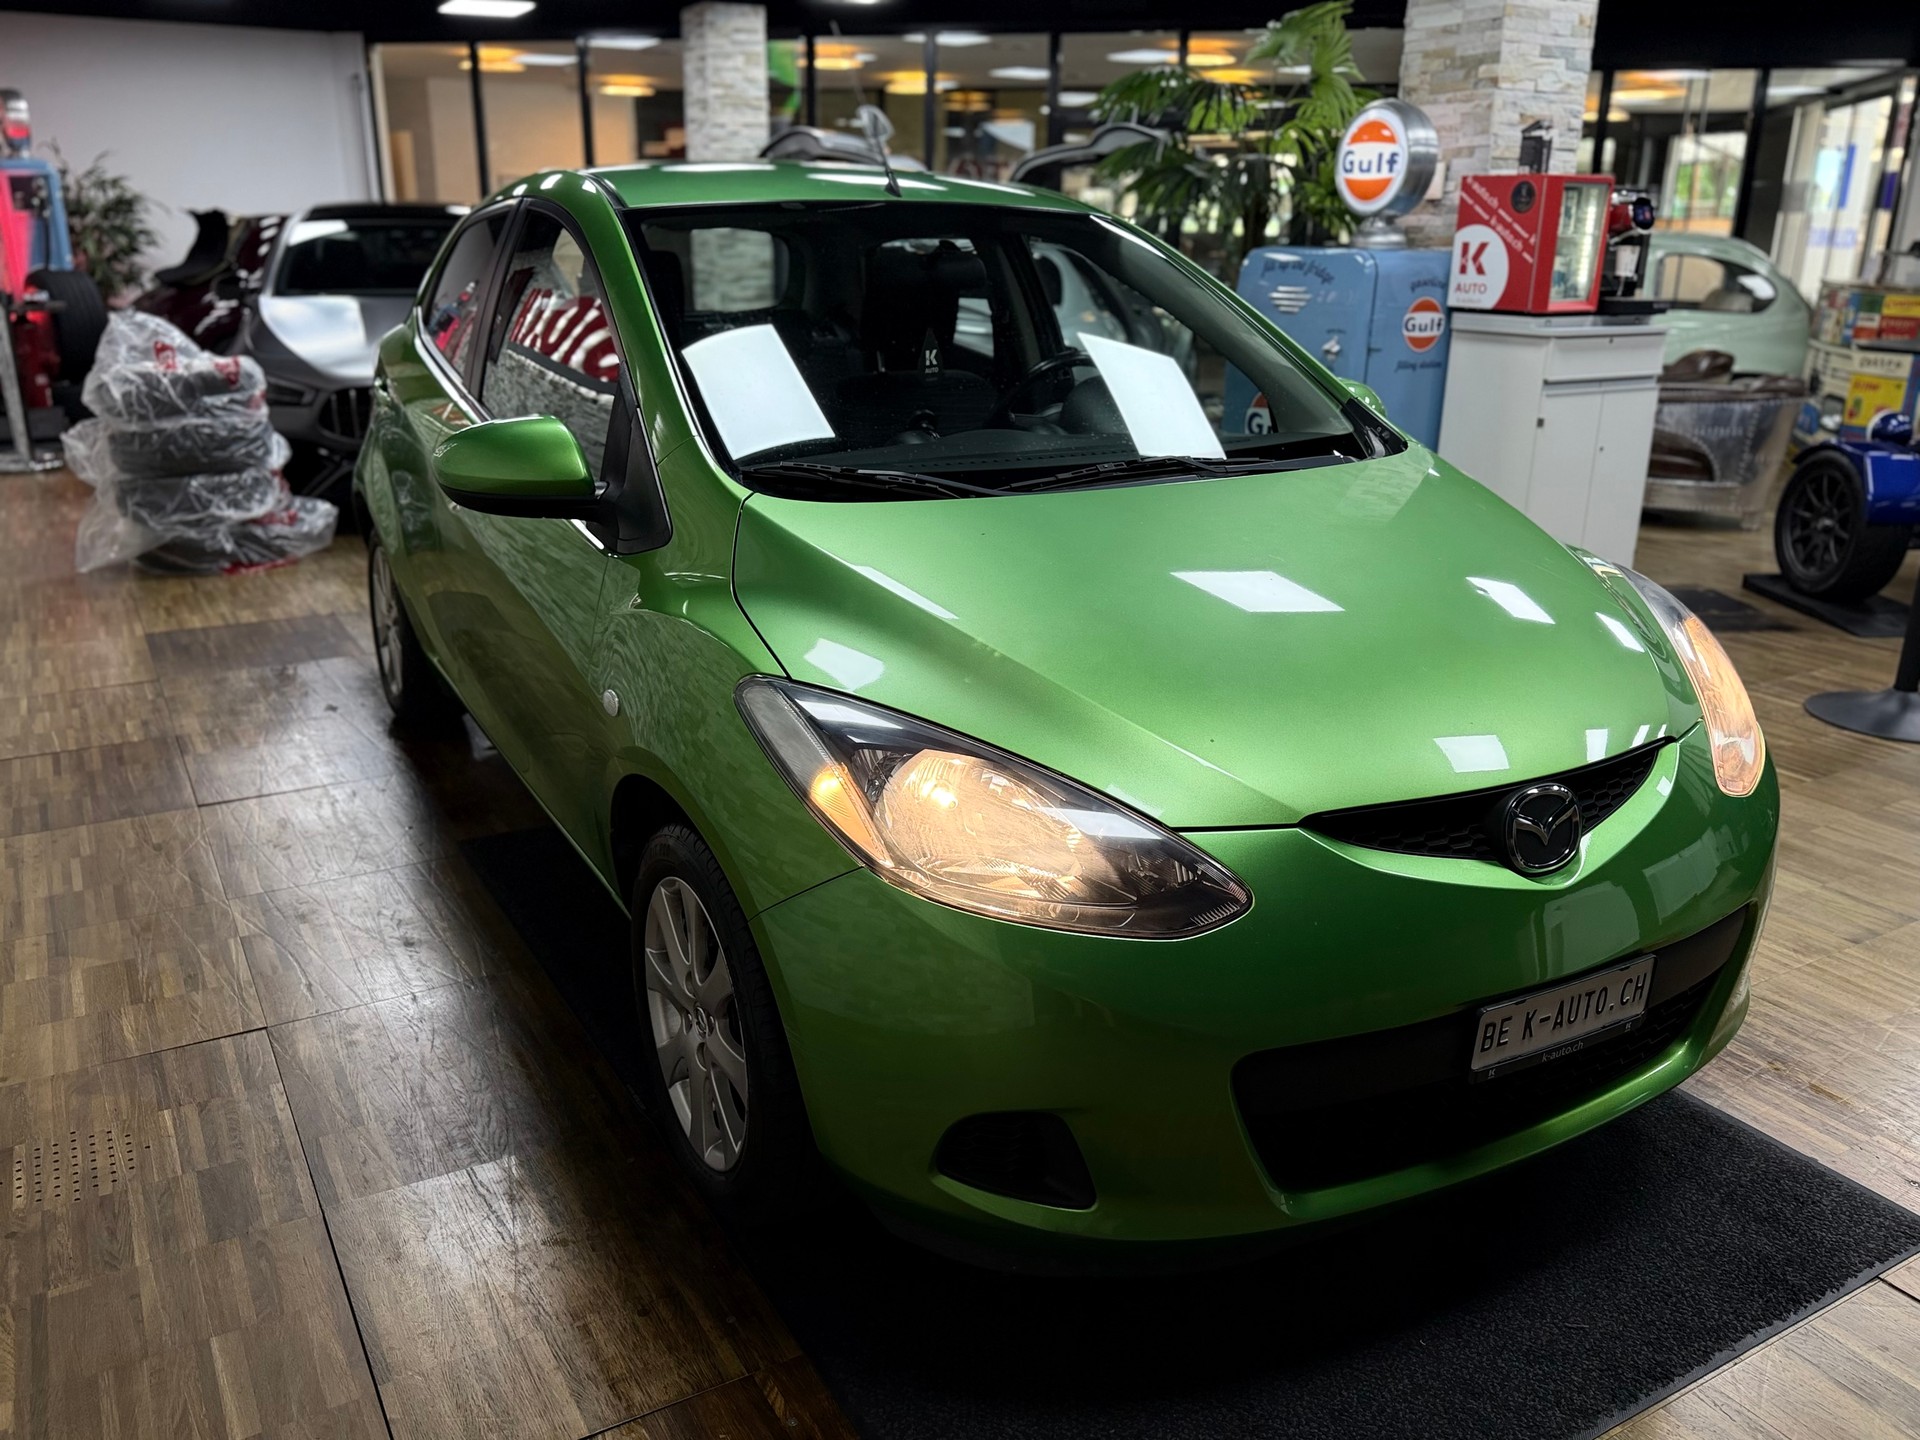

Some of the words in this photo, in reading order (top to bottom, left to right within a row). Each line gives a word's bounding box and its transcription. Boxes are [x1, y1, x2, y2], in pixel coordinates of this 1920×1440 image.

[1343, 150, 1399, 173] Gulf
[1459, 241, 1490, 276] K
[1454, 282, 1488, 295] AUTO
[1404, 316, 1443, 333] Gulf
[925, 349, 938, 366] K
[1480, 1015, 1513, 1053] BE
[1522, 972, 1648, 1041] K-AUTO.CH
[1541, 1040, 1584, 1064] k-auto.ch
